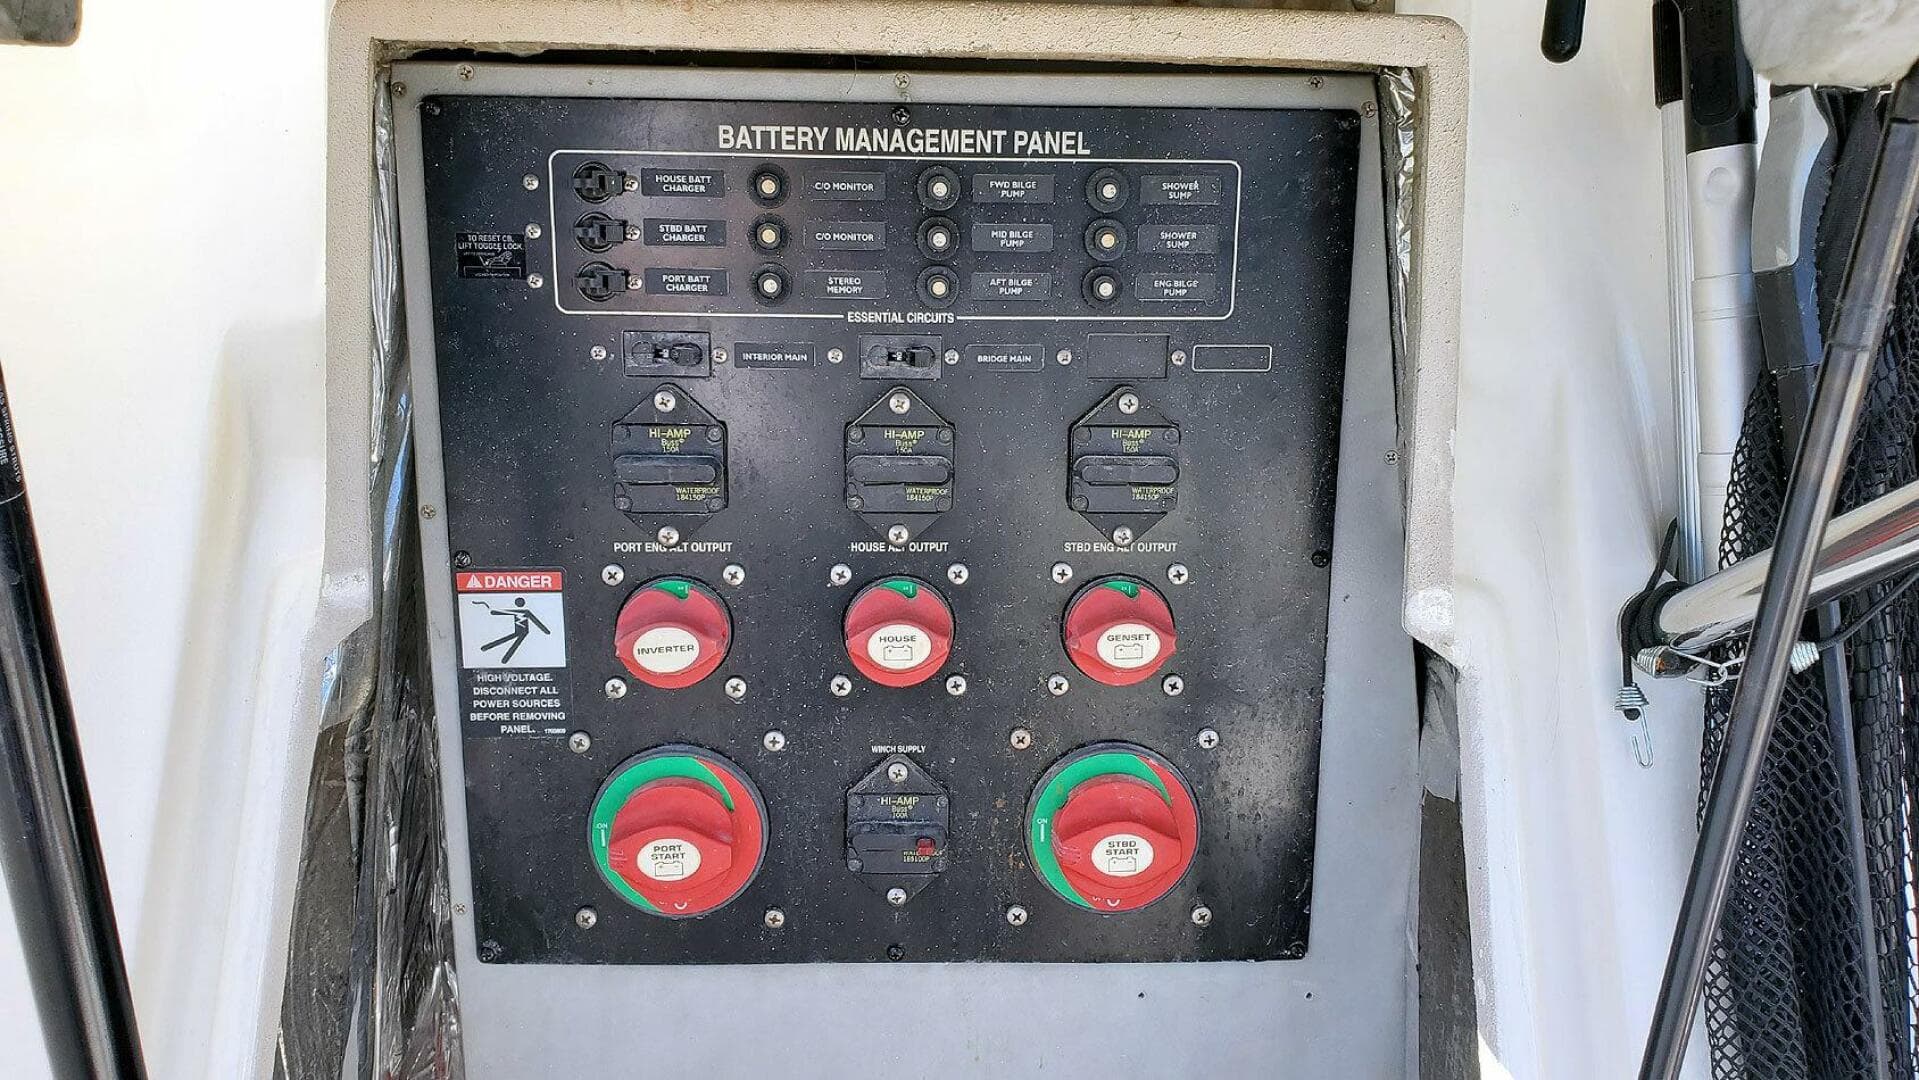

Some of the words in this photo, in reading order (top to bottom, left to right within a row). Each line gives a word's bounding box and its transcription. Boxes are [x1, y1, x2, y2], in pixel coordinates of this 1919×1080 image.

[718, 125, 828, 151] BATTERY
[836, 128, 1007, 154] MANAGEMENT
[1014, 131, 1090, 155] PANEL
[656, 174, 687, 183] HOUSE
[688, 175, 712, 184] BATT
[662, 184, 706, 192] CHARGER
[814, 182, 831, 190] C/O
[832, 182, 874, 192] MONITOR
[990, 181, 1010, 189] FWD
[1012, 181, 1036, 189] BILGE
[1162, 182, 1199, 191] SHOWER
[1000, 190, 1025, 198] PUMP
[1168, 192, 1192, 200] SUMP
[659, 224, 682, 232] STBD
[684, 224, 708, 232] BATT
[662, 233, 706, 242] CHARGER
[815, 232, 832, 240] C/O
[833, 232, 874, 242] MONITOR
[991, 230, 1008, 238] MID
[1009, 230, 1034, 238] BILGE
[1160, 232, 1197, 240] SHOWER
[1000, 240, 1024, 248] PUMP
[662, 274, 686, 282] PORT
[688, 275, 710, 283] BATT
[828, 276, 861, 285] STEREO
[1008, 278, 1033, 286] BILGE
[666, 284, 708, 292] CHARGER
[1154, 280, 1173, 288] ENG
[1174, 280, 1198, 288] BILGE
[827, 286, 862, 294] MEMORY
[999, 287, 1023, 295] PUMP
[1163, 288, 1188, 296] PUMP
[848, 311, 904, 323] ESSENTIAL
[906, 312, 954, 324] CIRCUITS
[742, 352, 784, 361] INTERIOR
[784, 352, 808, 362] MAIN
[978, 354, 1008, 363] BRIDGE
[1010, 354, 1032, 362] MAIN
[649, 428, 691, 438] HI-AMP
[884, 430, 924, 439] HI-AMP
[1112, 429, 1152, 439] HI-AMP
[614, 542, 642, 552] PORT
[645, 542, 667, 552] ENG
[690, 542, 732, 552] OUTPUT
[851, 542, 886, 552] HOUSE
[909, 542, 949, 552] OUTPUT
[1064, 542, 1091, 552] STBD
[1094, 542, 1114, 552] ENG
[1137, 542, 1178, 552] OUTPUT
[485, 576, 552, 588] DANGER
[879, 635, 916, 643] HOUSE
[1106, 634, 1151, 642] GENSET
[638, 644, 695, 655] INVERTER
[477, 673, 502, 682] HIGH
[473, 686, 538, 695] DISCONNECT
[540, 686, 558, 694] ALL
[473, 699, 510, 708] POWER
[512, 699, 560, 708] SOURCES
[470, 712, 510, 721] BEFORE
[512, 712, 566, 720] REMOVING
[880, 796, 919, 805] HI-AMP
